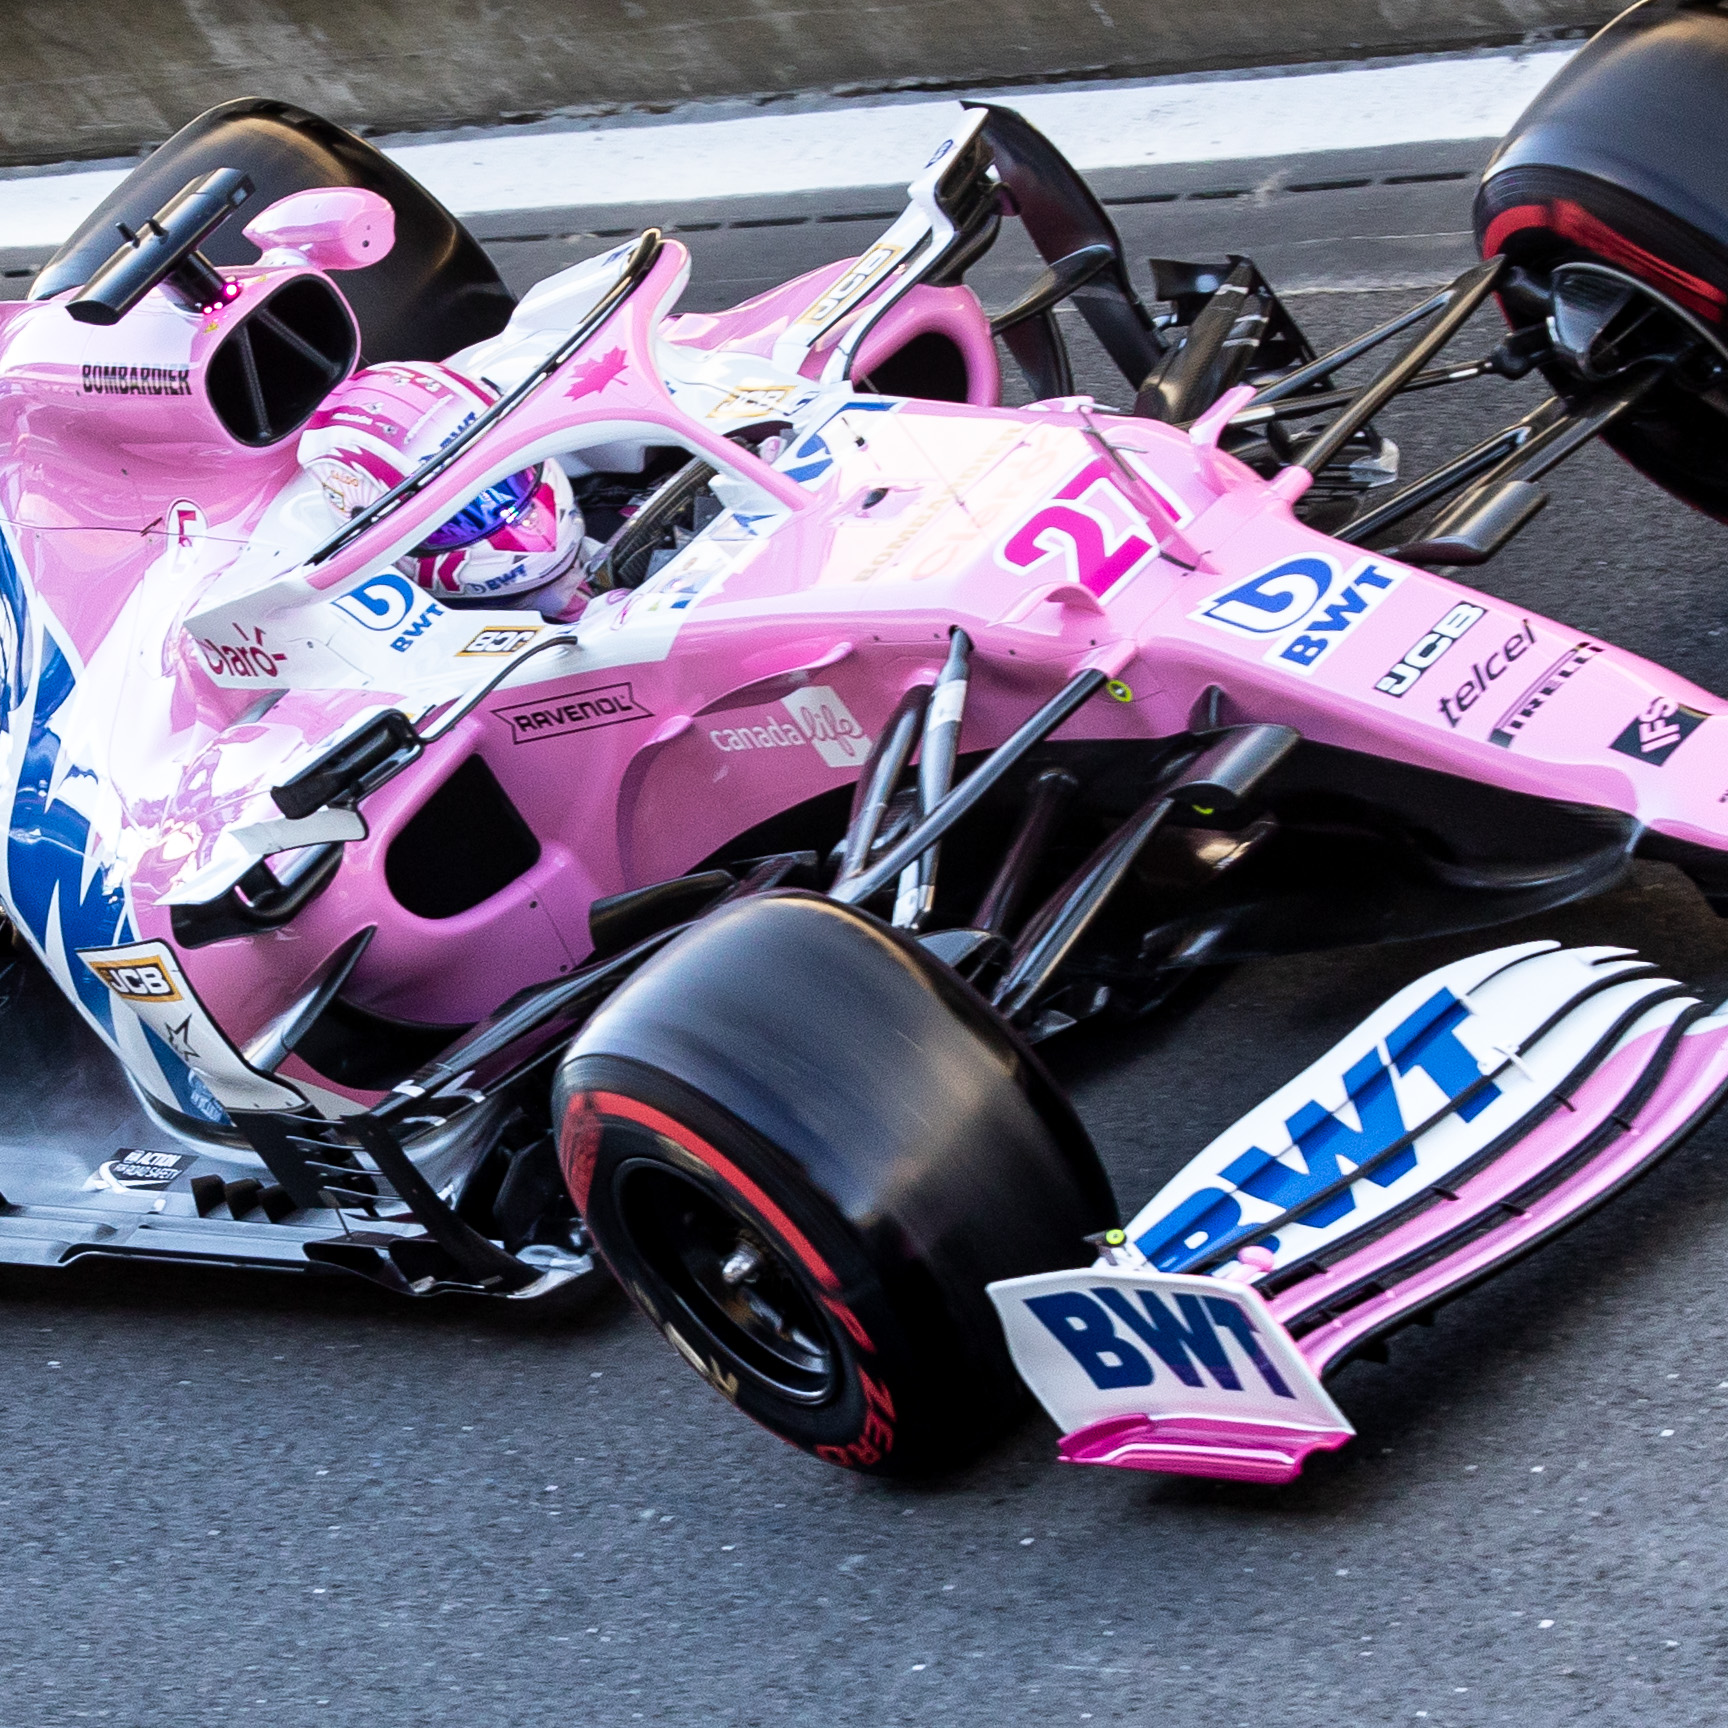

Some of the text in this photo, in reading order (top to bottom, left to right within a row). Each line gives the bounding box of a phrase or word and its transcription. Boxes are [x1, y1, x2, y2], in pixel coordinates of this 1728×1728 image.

[813, 249, 896, 321] JCB
[82, 363, 192, 396] BOMBARDIER
[1002, 450, 1186, 601] 27
[485, 564, 527, 591] BWT
[390, 602, 446, 653] BWT
[1279, 564, 1394, 666] BWT
[203, 621, 286, 678] Claro
[1375, 602, 1486, 697] JCB
[1439, 619, 1536, 729] telcel
[513, 694, 634, 733] RAVENOL
[709, 704, 866, 757] canada life
[1638, 696, 1682, 754] IFS
[109, 967, 172, 996] JCB
[1134, 987, 1503, 1274] BWT
[1024, 1287, 1296, 1400] BWT
